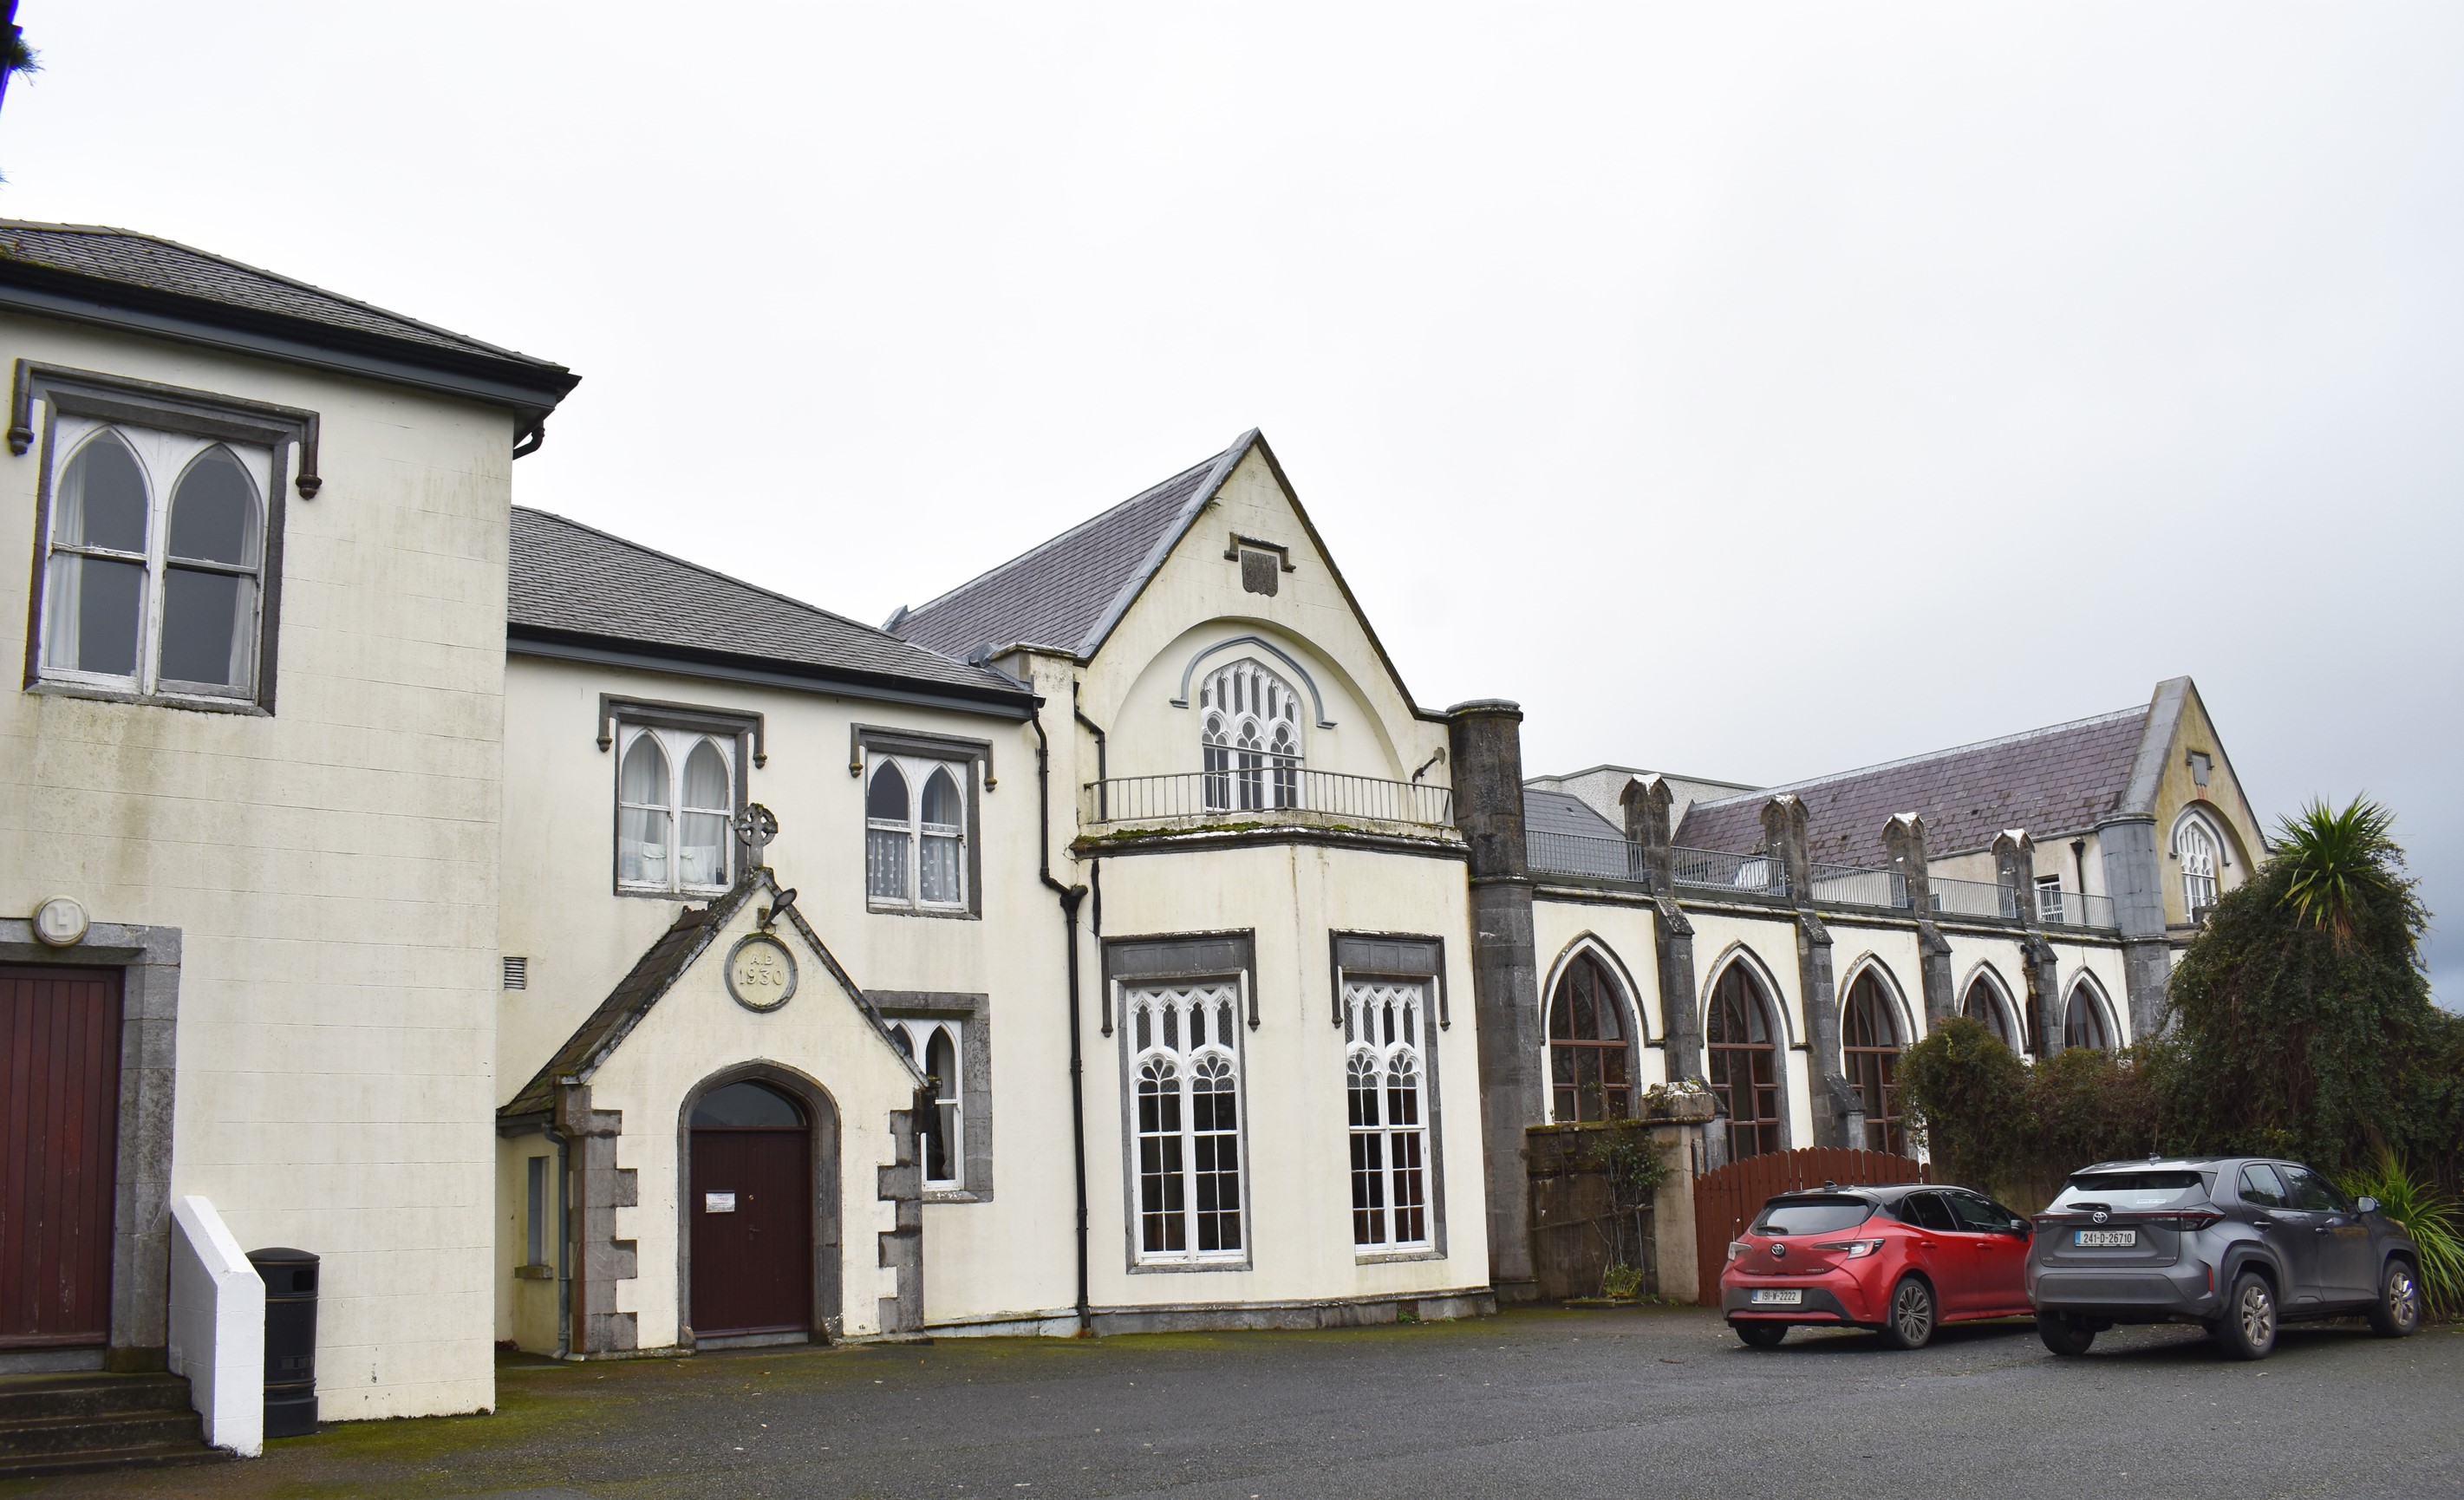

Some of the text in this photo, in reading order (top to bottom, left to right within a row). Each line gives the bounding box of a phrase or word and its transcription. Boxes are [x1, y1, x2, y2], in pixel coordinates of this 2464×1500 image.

[739, 968, 784, 986] 1930
[2083, 1233, 2132, 1243] 241-D-26710
[1762, 1291, 1796, 1301] 191-W-2222
